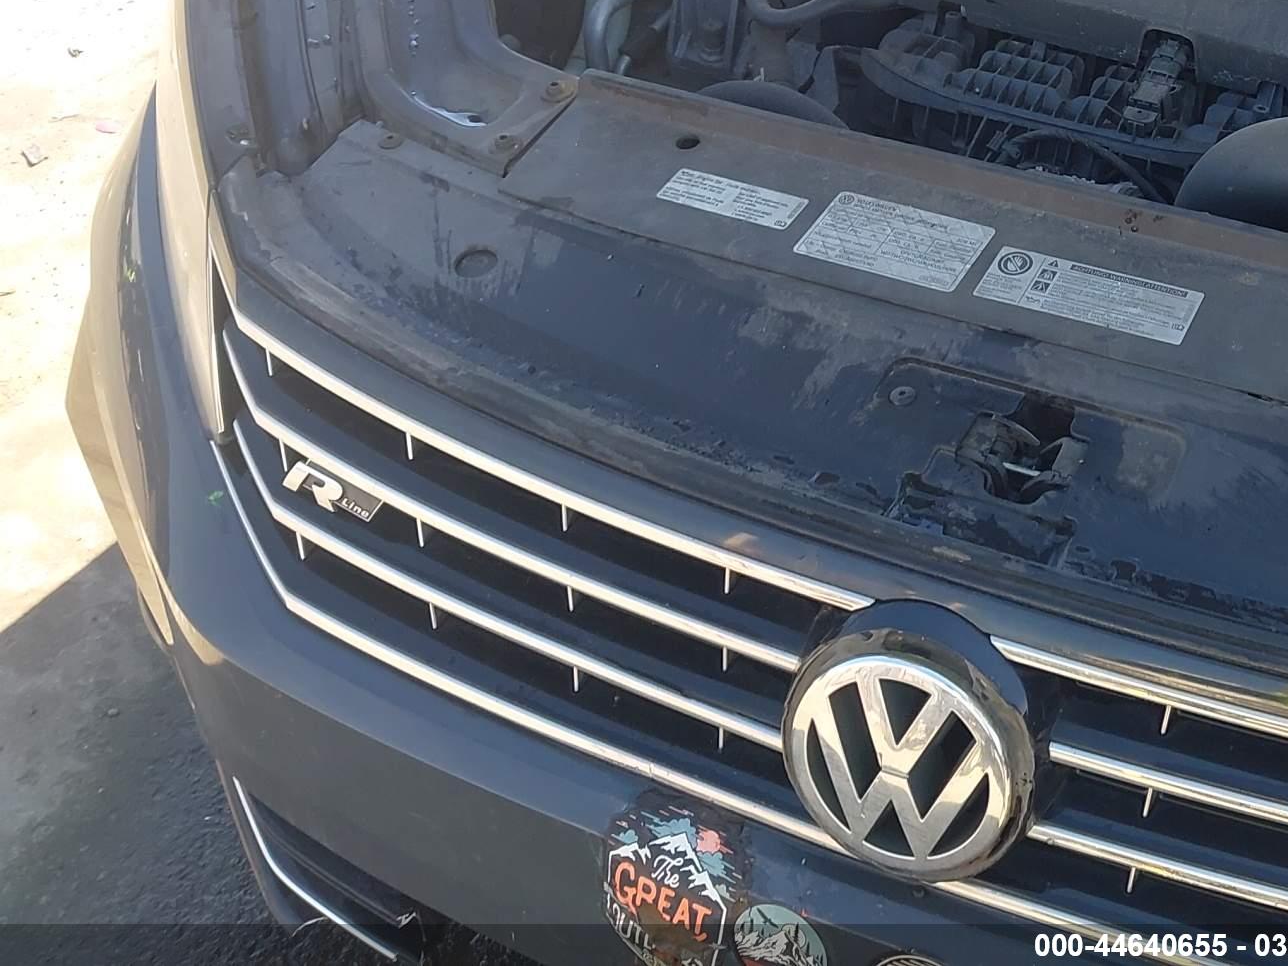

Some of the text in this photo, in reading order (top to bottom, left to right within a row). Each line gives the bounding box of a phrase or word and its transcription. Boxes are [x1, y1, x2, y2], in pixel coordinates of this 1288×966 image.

[282, 461, 370, 519] R Line
[651, 855, 684, 889] The
[615, 861, 713, 942] GREAT
